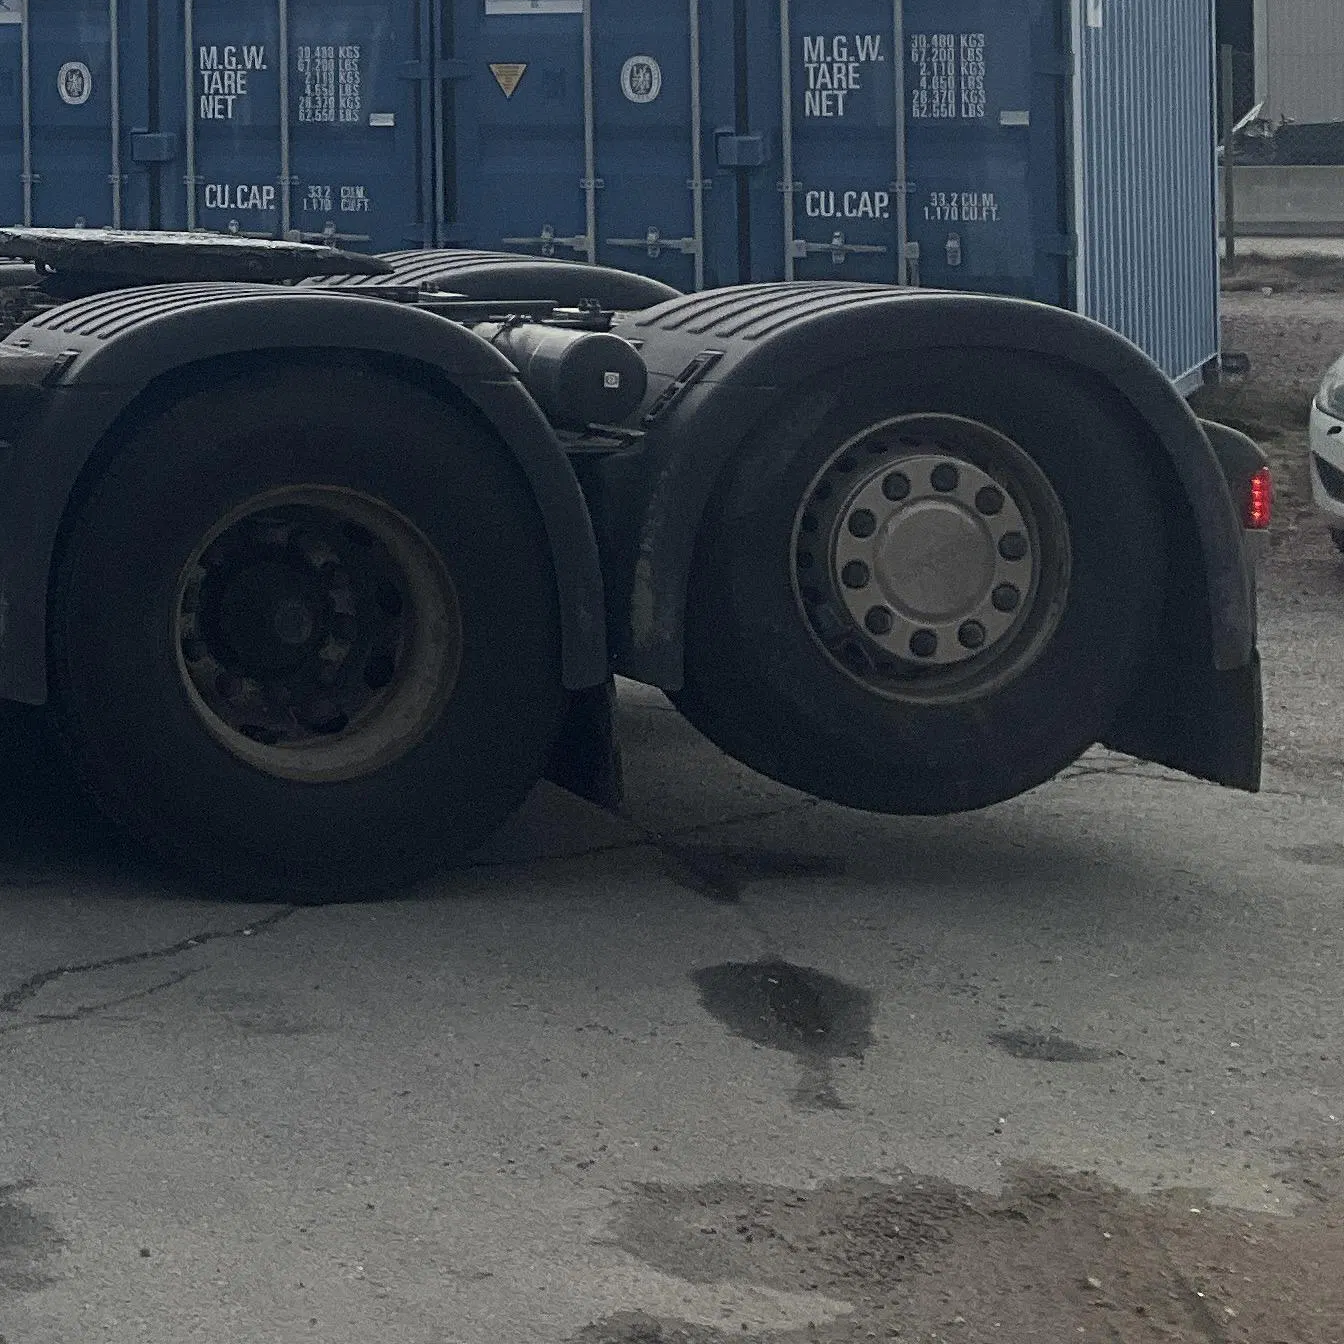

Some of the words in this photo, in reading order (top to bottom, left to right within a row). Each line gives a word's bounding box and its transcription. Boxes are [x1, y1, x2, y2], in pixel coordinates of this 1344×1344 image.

[912, 33, 954, 48] 30.480
[961, 33, 985, 48] KGS
[339, 46, 360, 59] KGS
[803, 35, 884, 62] M.G.W.
[912, 48, 954, 62] 67.200
[961, 48, 983, 62] LBS
[199, 46, 267, 70] M.G.W.
[339, 59, 359, 71] LBS
[804, 62, 860, 89] TARE
[920, 62, 954, 76] 2.110
[961, 62, 985, 76] KGS
[201, 70, 247, 94] TARE
[339, 71, 360, 84] KGS
[961, 76, 983, 89] LBS
[339, 84, 359, 96] LBS
[912, 90, 955, 104] 28.370
[961, 90, 986, 104] KGS
[200, 95, 236, 119] NET
[339, 96, 361, 109] KGS
[805, 90, 847, 117] NET
[339, 109, 359, 122] LBS
[912, 104, 955, 118] 62.550
[962, 104, 984, 118] LBS
[205, 184, 275, 209] CU.CAP.
[930, 192, 958, 206] 33.2
[805, 190, 889, 218] CU.CAP.
[924, 206, 958, 221] 1.170
